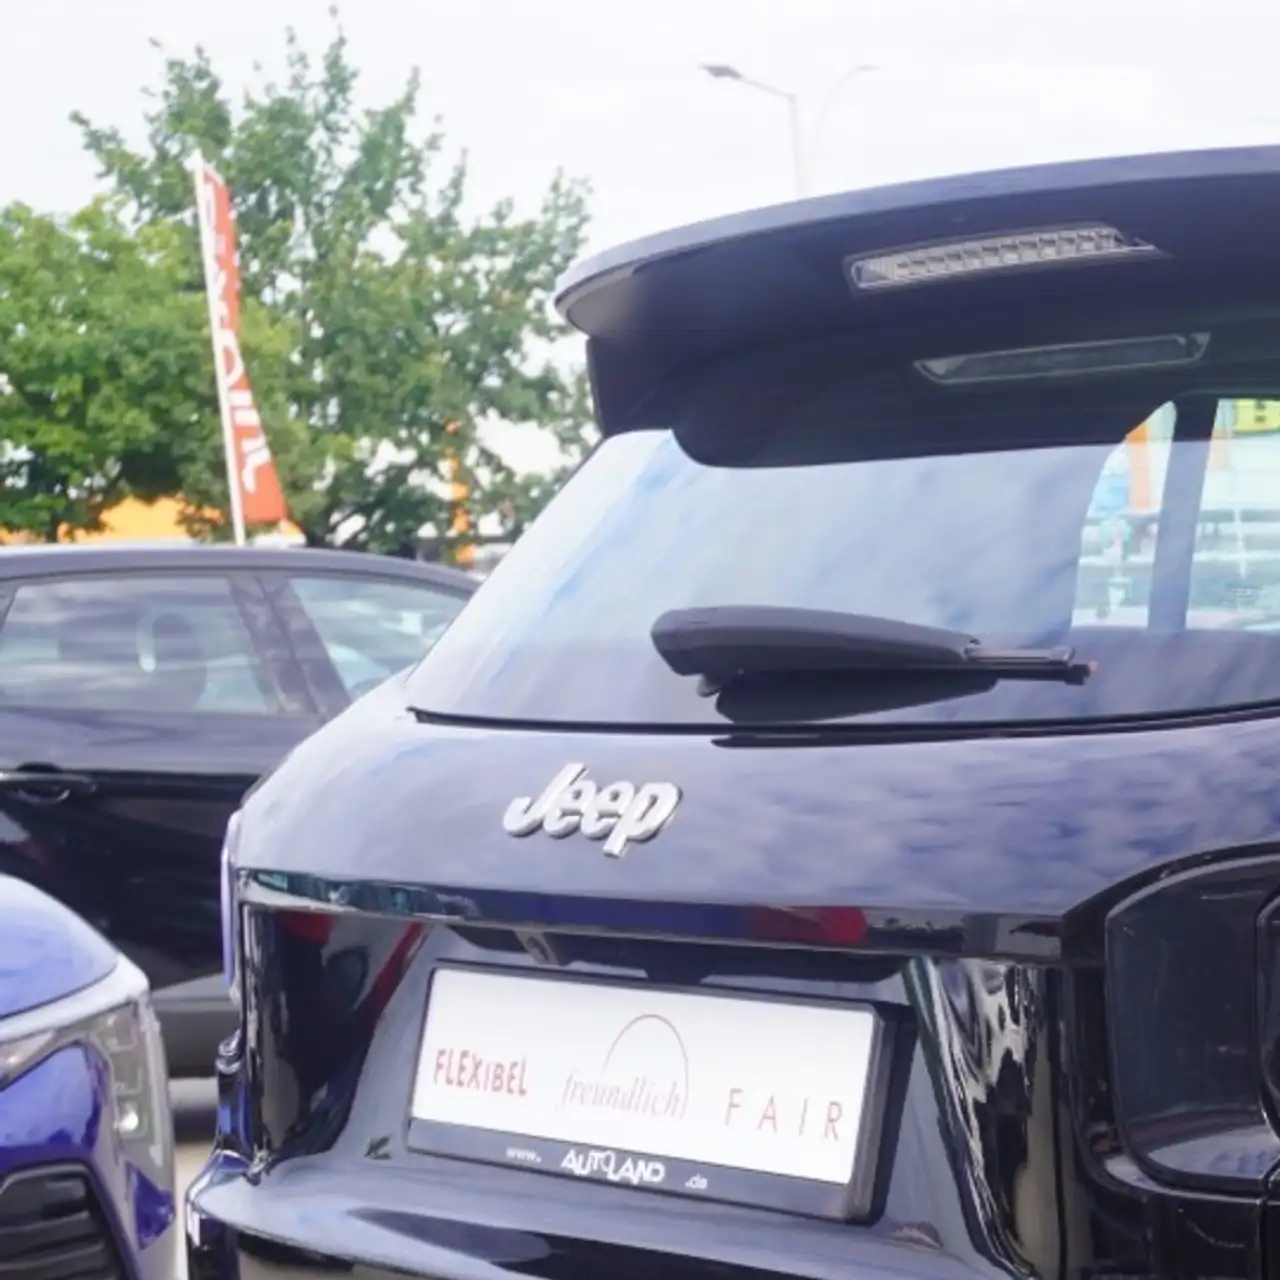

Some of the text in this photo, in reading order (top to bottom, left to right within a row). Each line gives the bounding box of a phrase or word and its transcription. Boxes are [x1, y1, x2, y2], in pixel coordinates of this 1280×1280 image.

[503, 762, 682, 858] Jeep
[434, 1048, 844, 1141] FLEXIBEL freundlich FAIR
[561, 1149, 666, 1184] AUTOLAND
